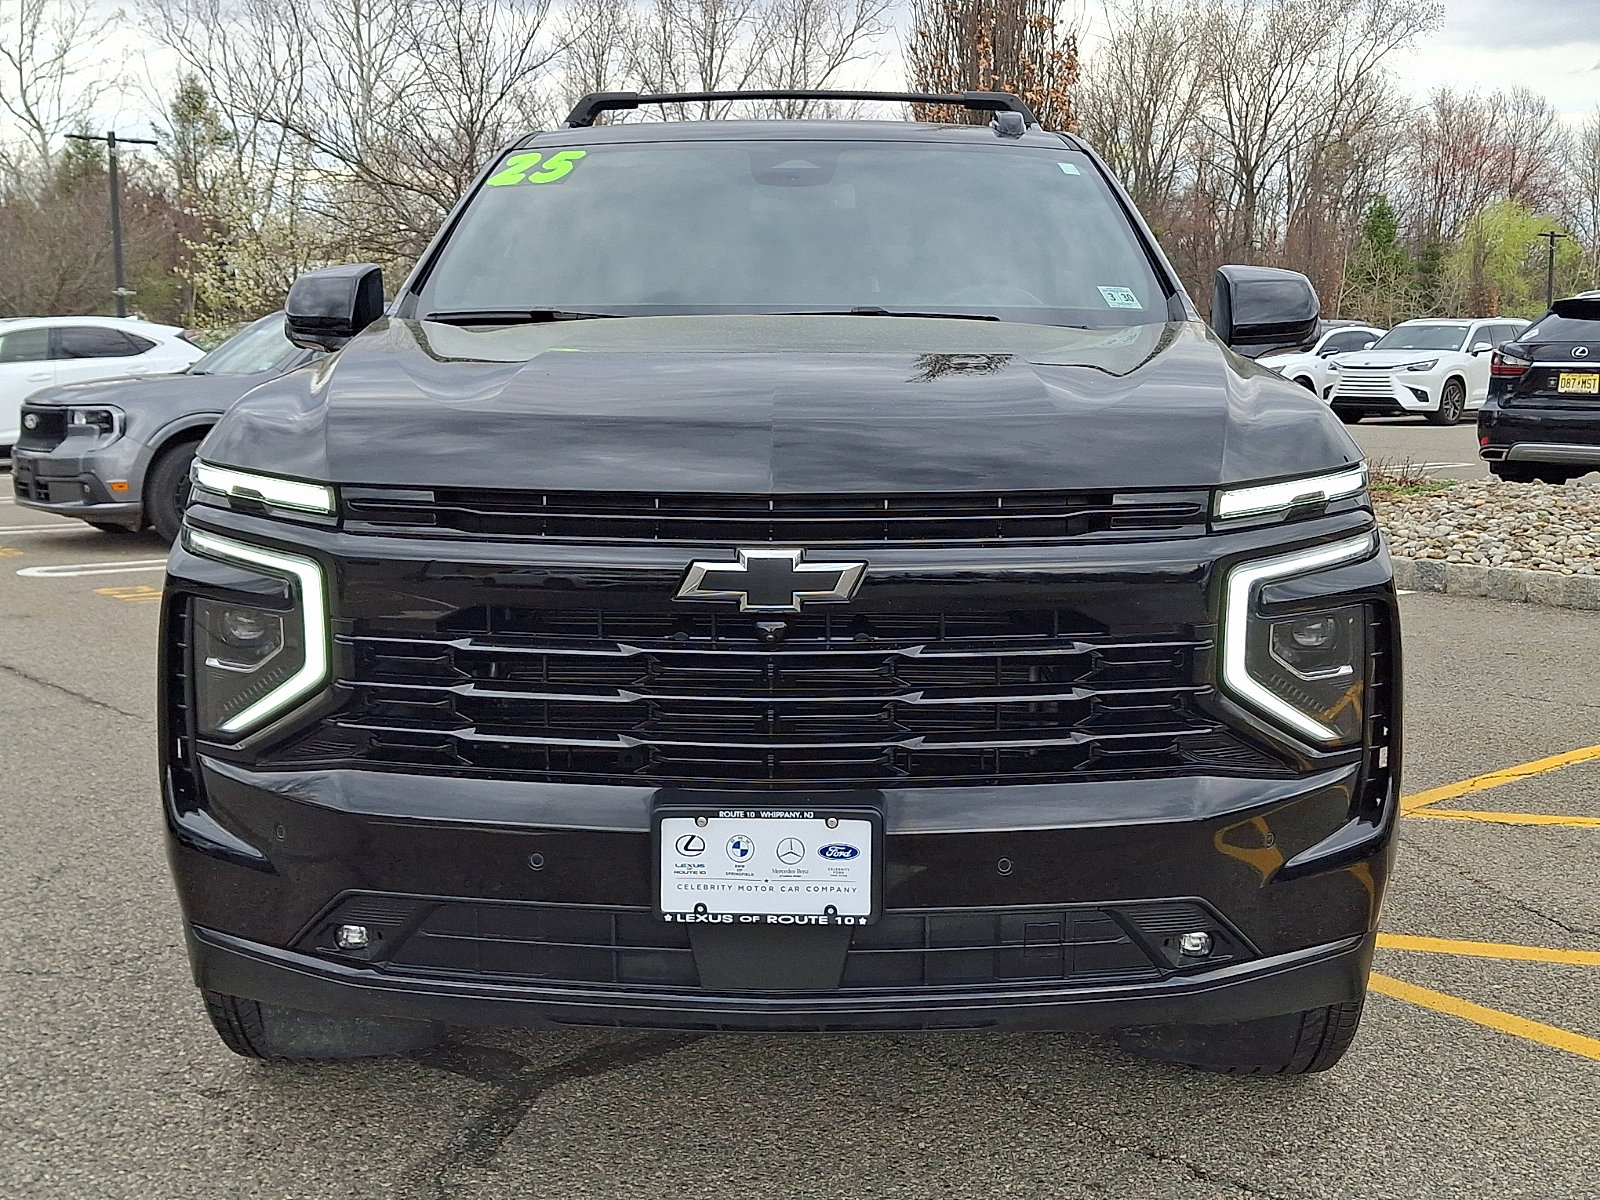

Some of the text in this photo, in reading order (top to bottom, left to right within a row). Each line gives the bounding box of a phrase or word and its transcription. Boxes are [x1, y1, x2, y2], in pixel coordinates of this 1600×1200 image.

[487, 150, 587, 187] 25
[1107, 293, 1116, 301] 3
[719, 810, 745, 818] ROUTE
[803, 811, 814, 819] NJ
[825, 846, 853, 858] Ford
[676, 883, 733, 891] CELEBRITY
[780, 885, 800, 893] CAR
[806, 885, 857, 893] COMPANY
[676, 913, 855, 926] LEXUS OF ROUTE 10
